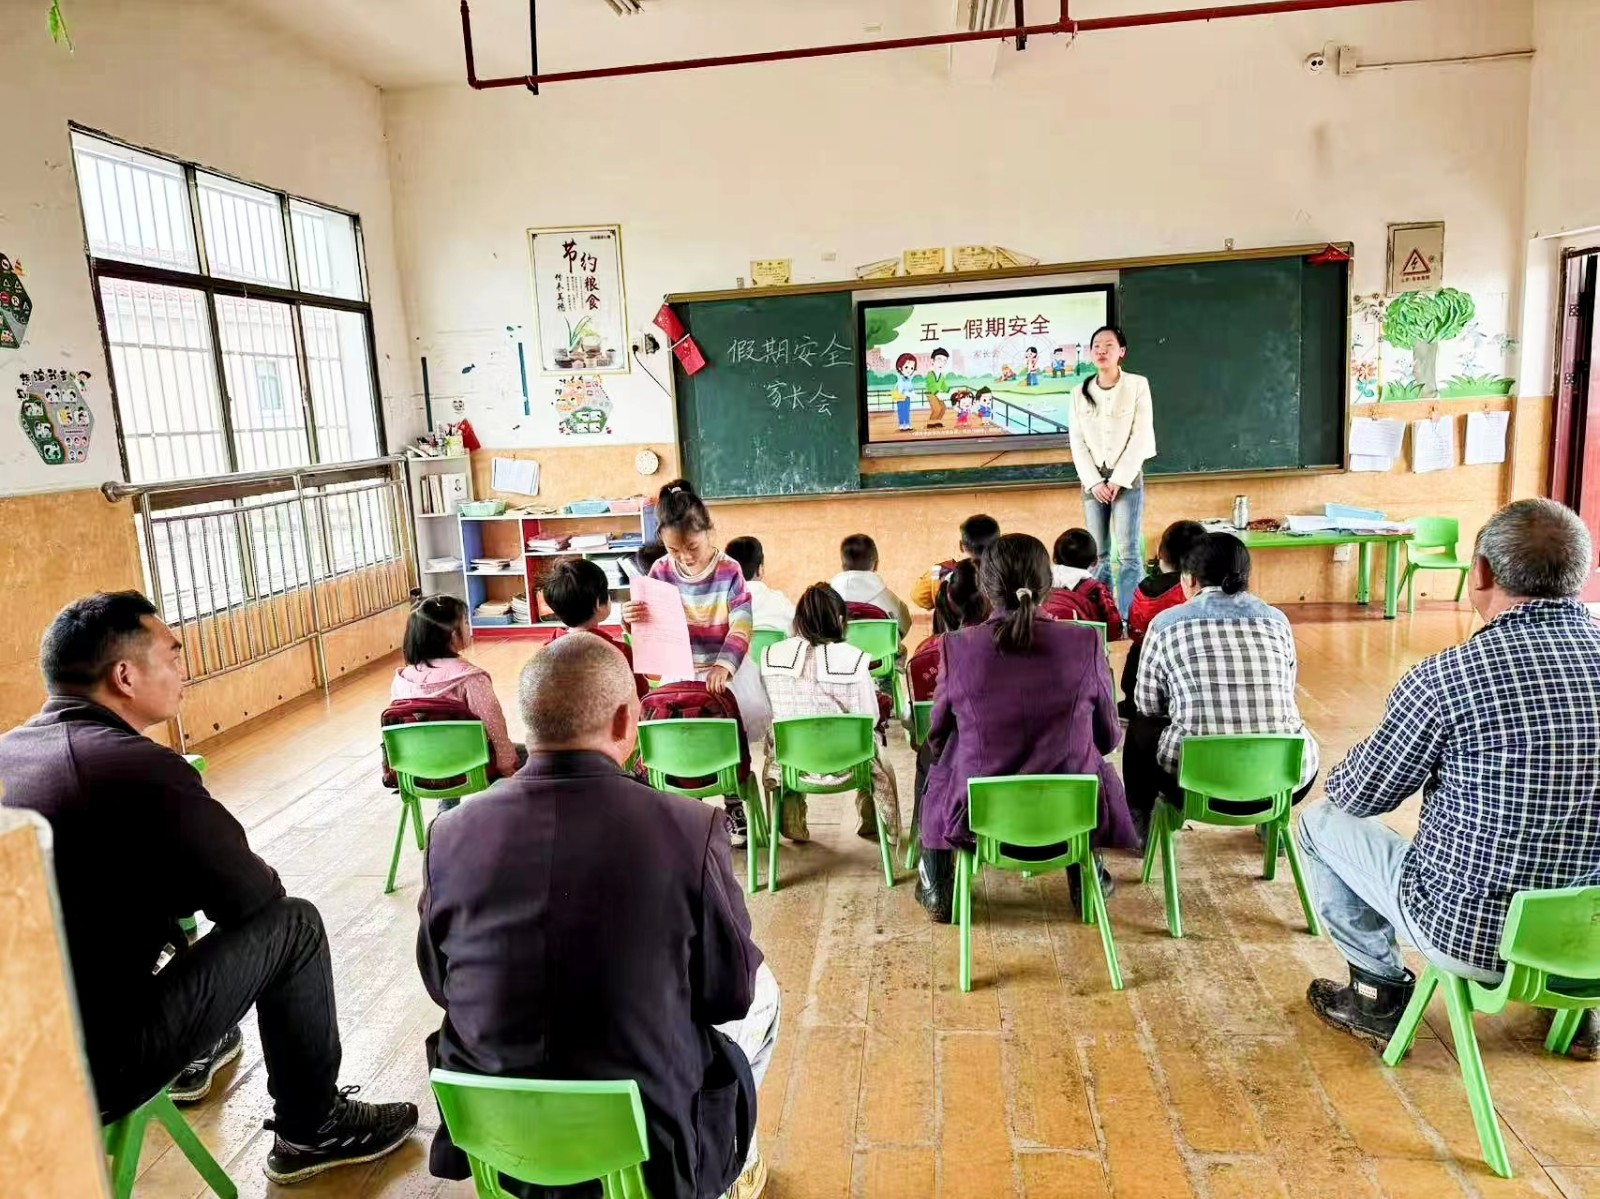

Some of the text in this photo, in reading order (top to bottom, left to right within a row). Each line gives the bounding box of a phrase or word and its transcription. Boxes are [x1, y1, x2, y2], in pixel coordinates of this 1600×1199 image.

[562, 238, 600, 310] 节约粮食
[920, 314, 1050, 342] 五一假期安全
[727, 332, 855, 367] 假期安全
[763, 380, 839, 416] 家长会
